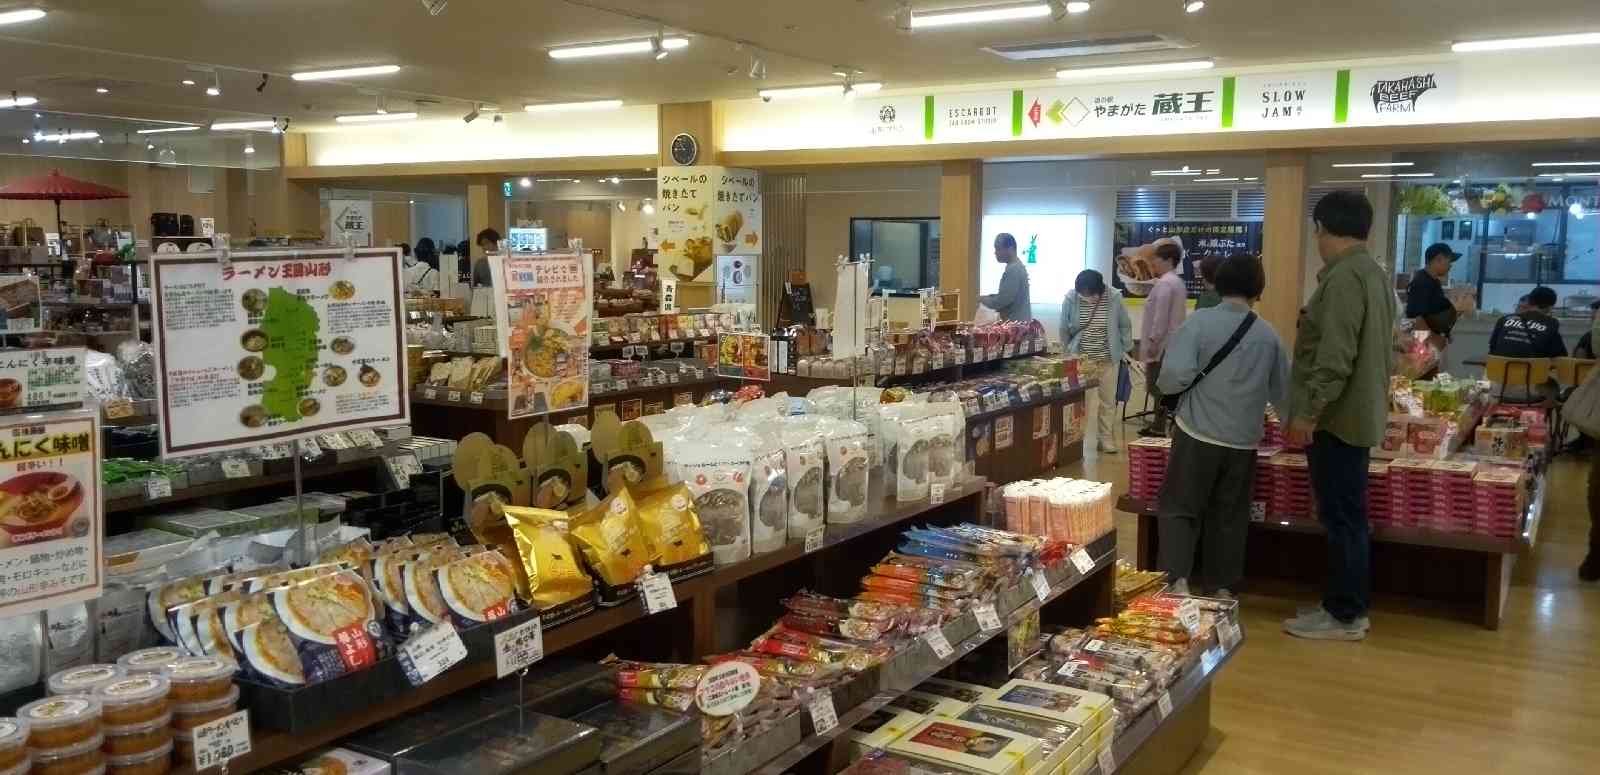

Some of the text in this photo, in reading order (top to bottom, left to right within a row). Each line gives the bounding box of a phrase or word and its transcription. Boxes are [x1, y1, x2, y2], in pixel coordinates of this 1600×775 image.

[1377, 73, 1436, 94] TAKAHASHI
[1262, 90, 1306, 104] SLOW
[1379, 92, 1417, 102] BEEF
[1152, 91, 1215, 116] 蔵王
[1378, 102, 1413, 114] FARM
[1094, 103, 1147, 118] やまがた
[1262, 106, 1292, 119] JAM
[662, 174, 708, 185] シベールの
[721, 175, 755, 187] シベールの
[662, 188, 697, 200] 焼きたて
[662, 204, 680, 213] パン
[223, 260, 332, 281] ラーメン王国山形
